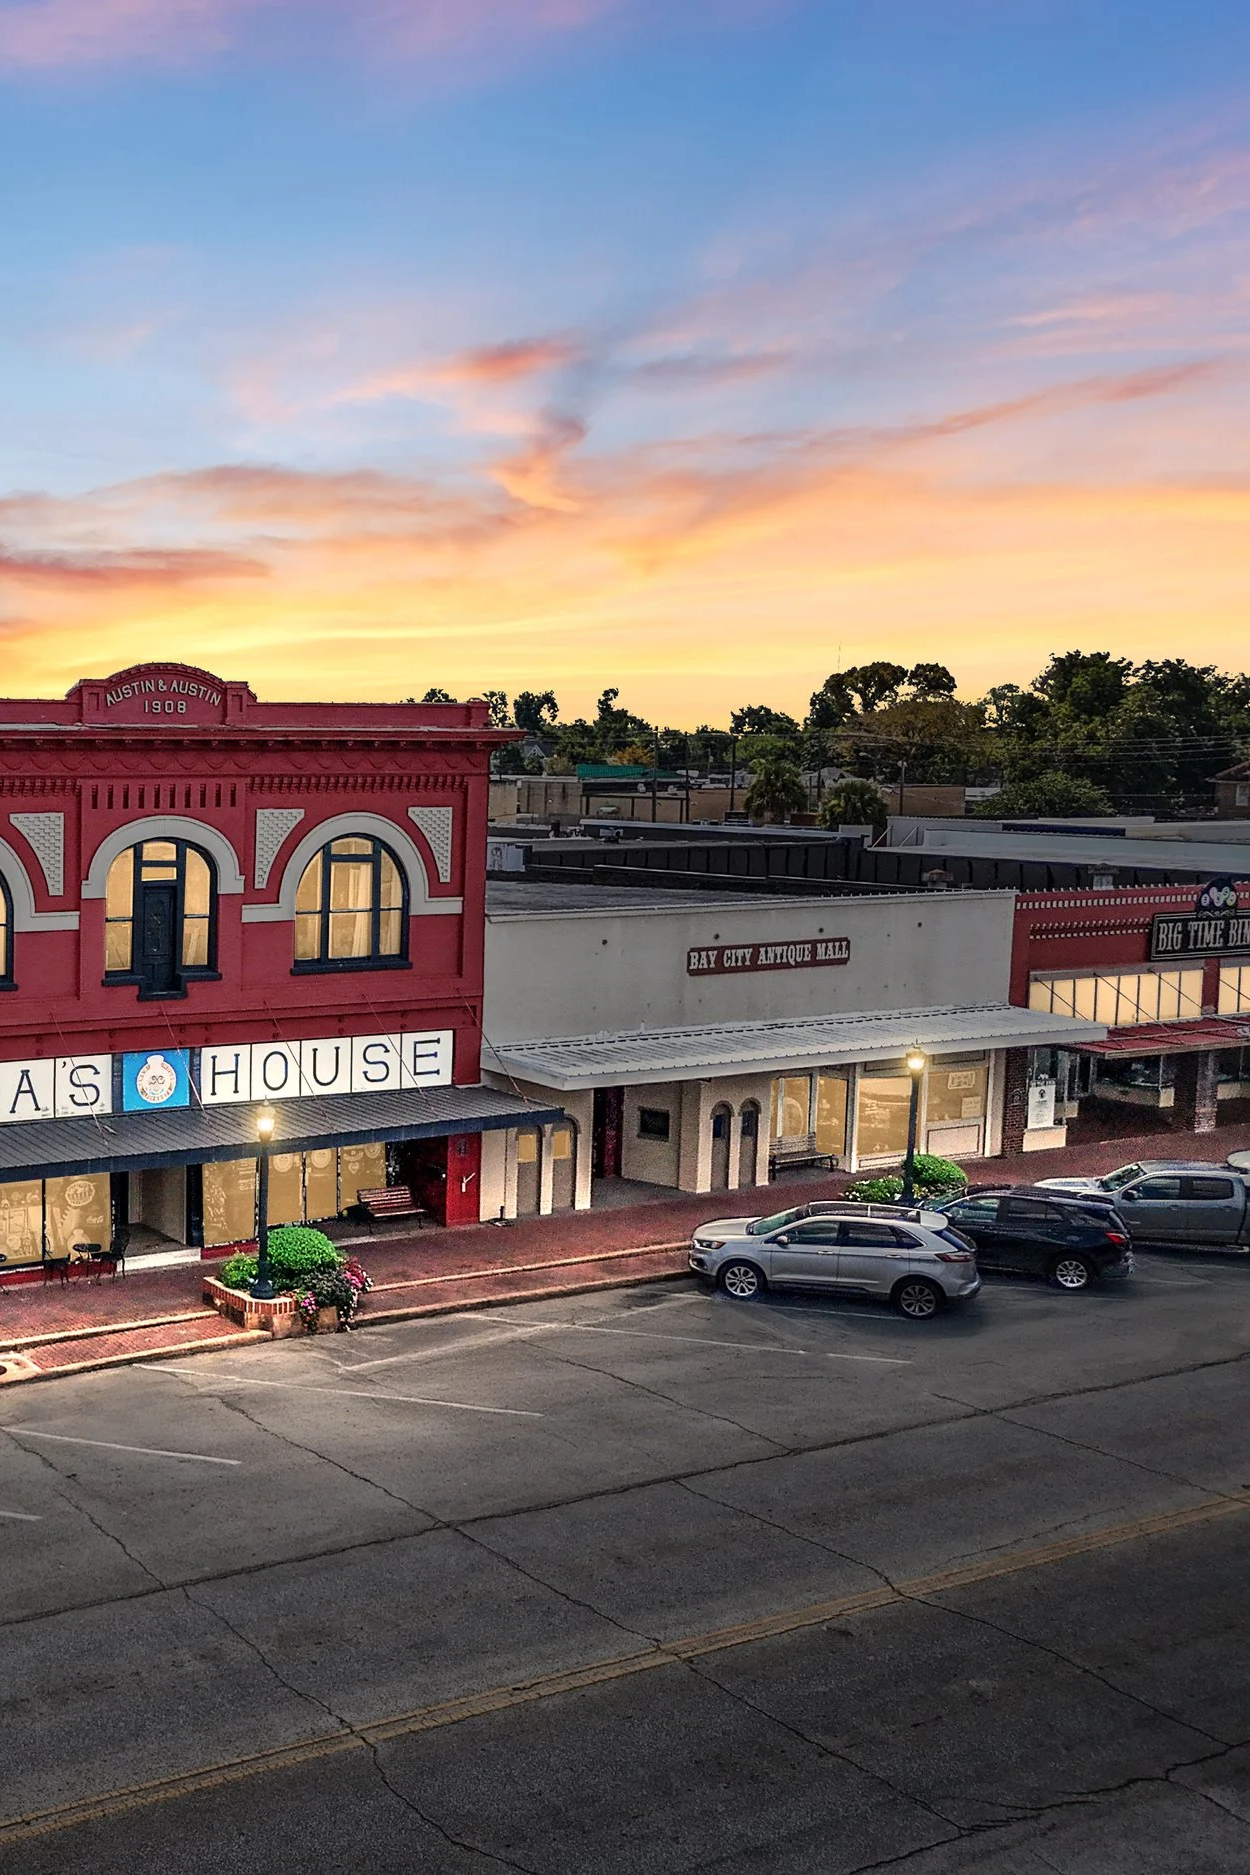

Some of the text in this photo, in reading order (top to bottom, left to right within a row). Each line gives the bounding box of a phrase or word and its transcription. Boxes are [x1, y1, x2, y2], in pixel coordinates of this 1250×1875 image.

[106, 679, 221, 706] AUSTIN & AUSTIN
[144, 700, 187, 713] 1908
[1157, 922, 1183, 951] BIG
[1188, 920, 1225, 949] TIME
[689, 941, 848, 970] BAY CITY ANTIQUE MALL
[211, 1038, 441, 1095] HOUSE
